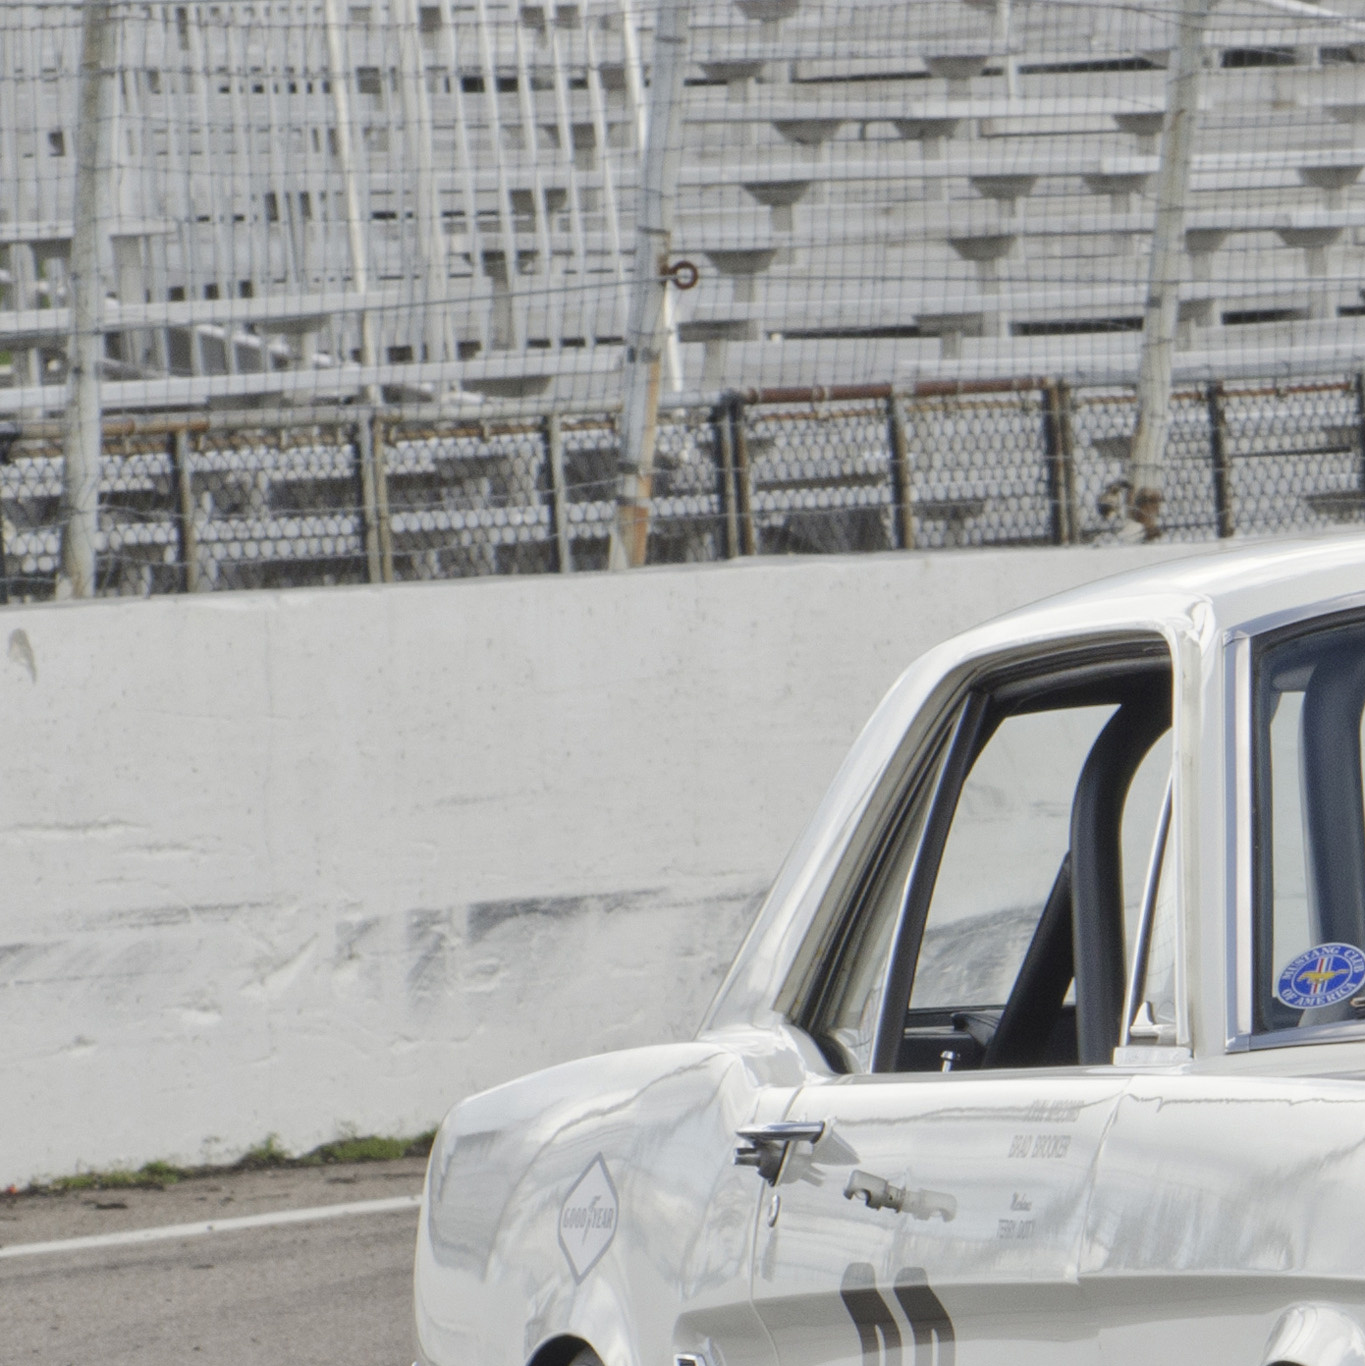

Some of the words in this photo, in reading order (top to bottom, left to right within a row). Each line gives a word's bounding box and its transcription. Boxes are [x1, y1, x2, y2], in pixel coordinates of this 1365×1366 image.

[1281, 946, 1342, 981] MUSTANG
[1343, 949, 1365, 973] CLUB
[1281, 988, 1298, 1001] OF
[1294, 982, 1358, 1007] AMERICA
[562, 1207, 615, 1229] GOODYEAR
